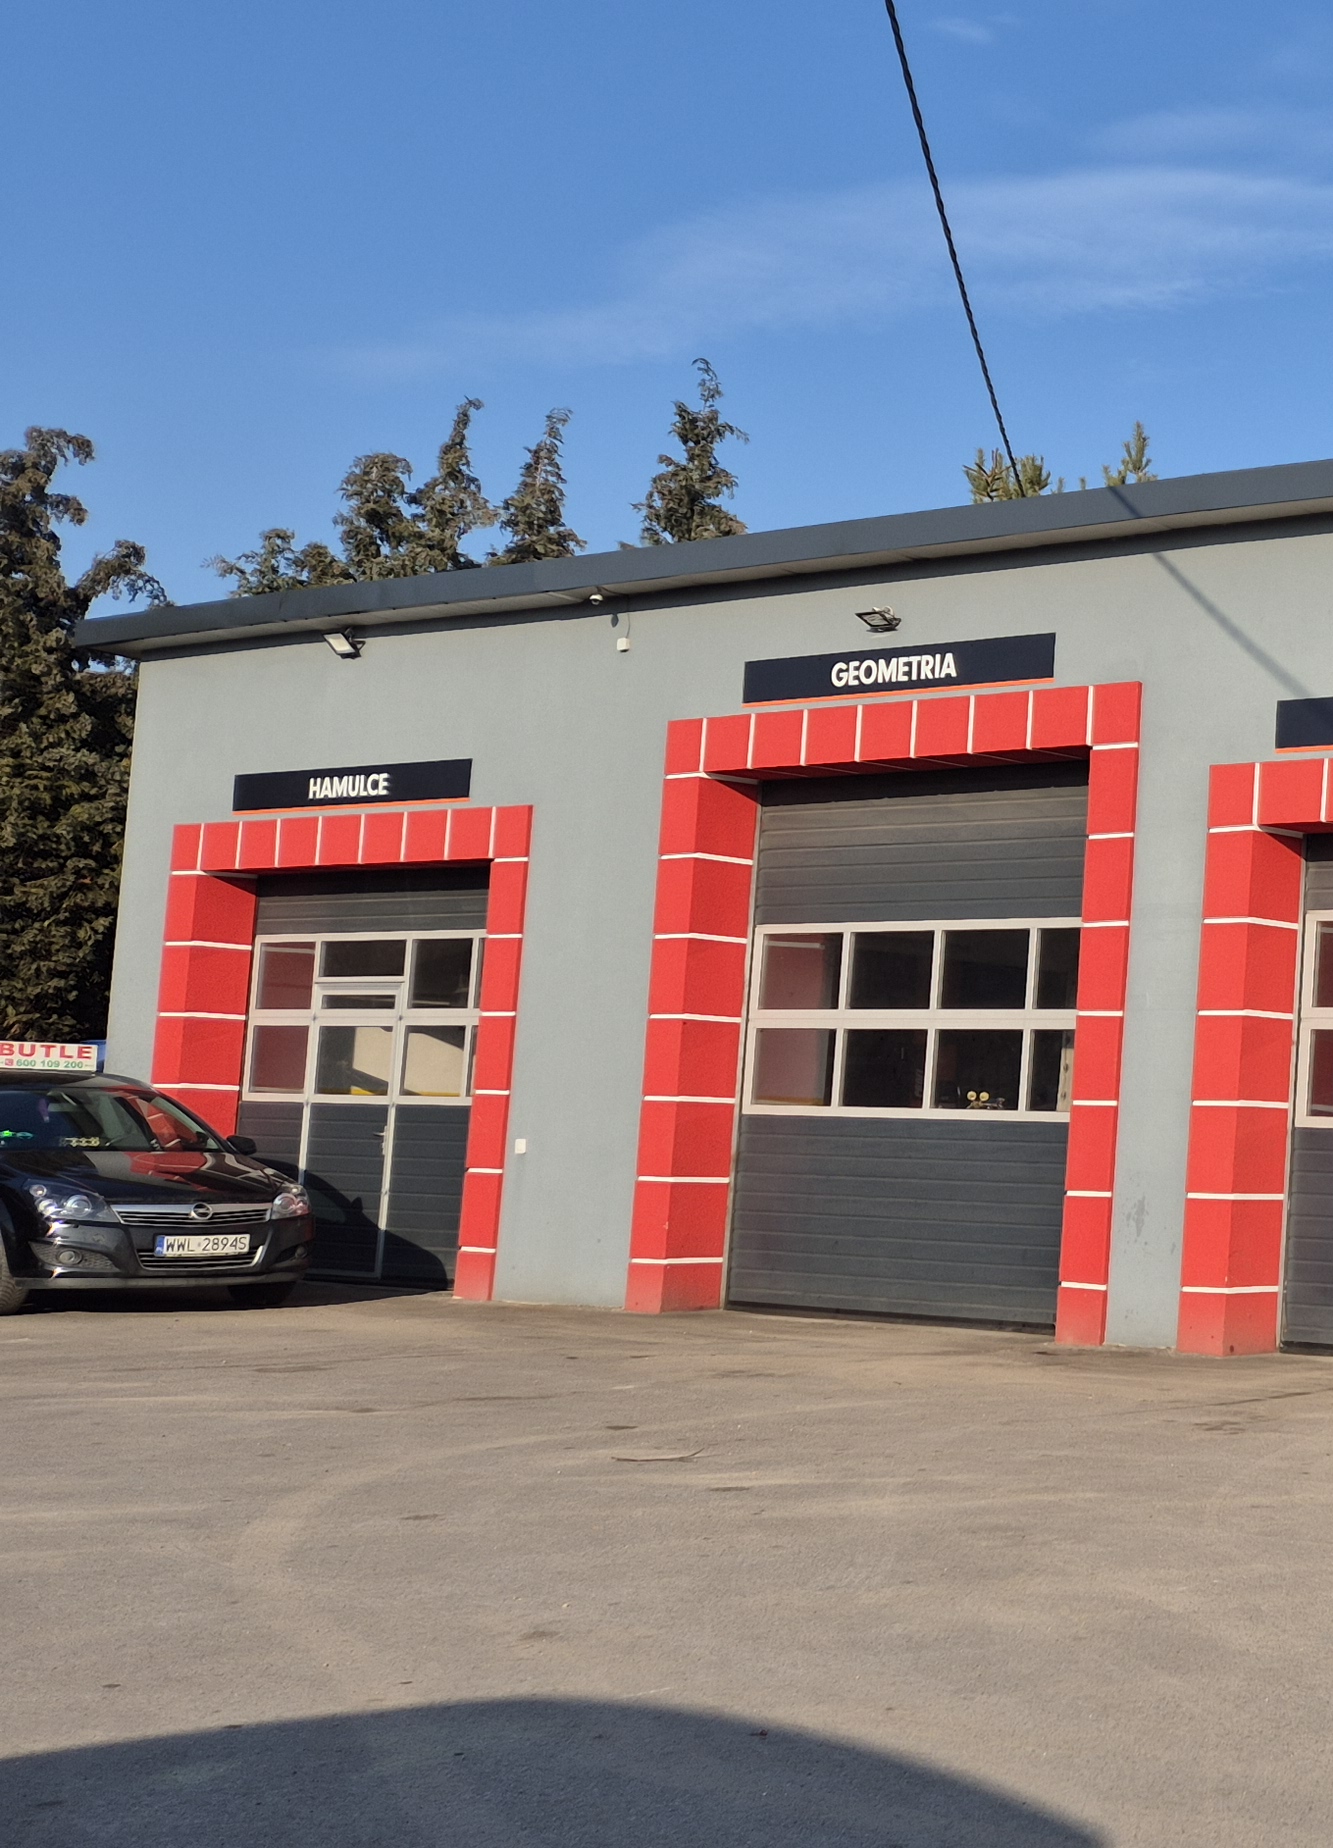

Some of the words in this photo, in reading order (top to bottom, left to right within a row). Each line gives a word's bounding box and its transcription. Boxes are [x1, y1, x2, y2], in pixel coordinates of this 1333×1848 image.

[831, 653, 957, 687] GEOMETRIA
[308, 773, 389, 799] HAMULCE
[0, 1043, 92, 1059] BUTLE
[16, 1059, 36, 1068] 600
[41, 1059, 60, 1068] 109
[64, 1061, 84, 1069] 200
[166, 1238, 195, 1252] WWL
[202, 1236, 247, 1252] 2894S
